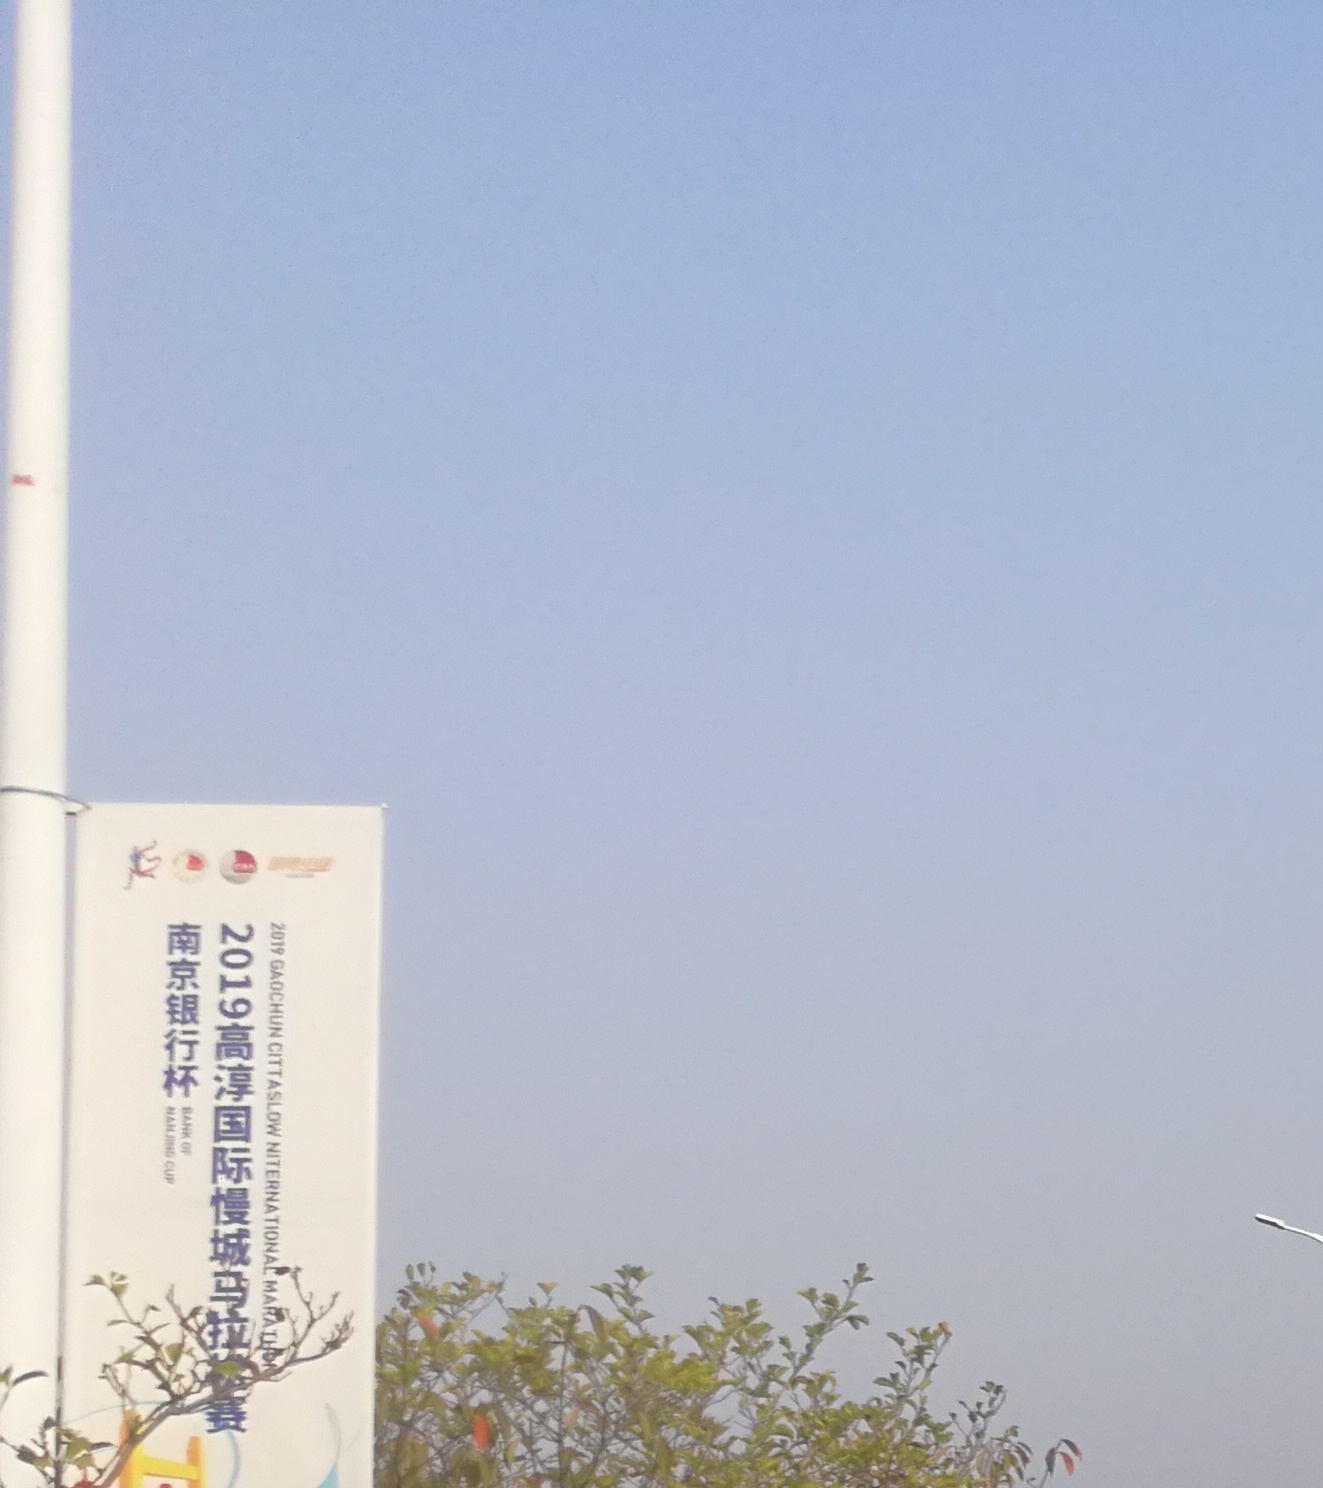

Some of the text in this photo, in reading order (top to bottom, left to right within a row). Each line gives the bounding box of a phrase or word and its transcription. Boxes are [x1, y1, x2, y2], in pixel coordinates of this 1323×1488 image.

[269, 922, 286, 955] 2019
[163, 922, 202, 1098] 南京银行杯
[267, 959, 285, 1037] GAOCHUN
[181, 1107, 193, 1139] BANK
[265, 1041, 283, 1137] CITTASLOW
[206, 923, 255, 1433] 2019高淳国际慢城马拉赛
